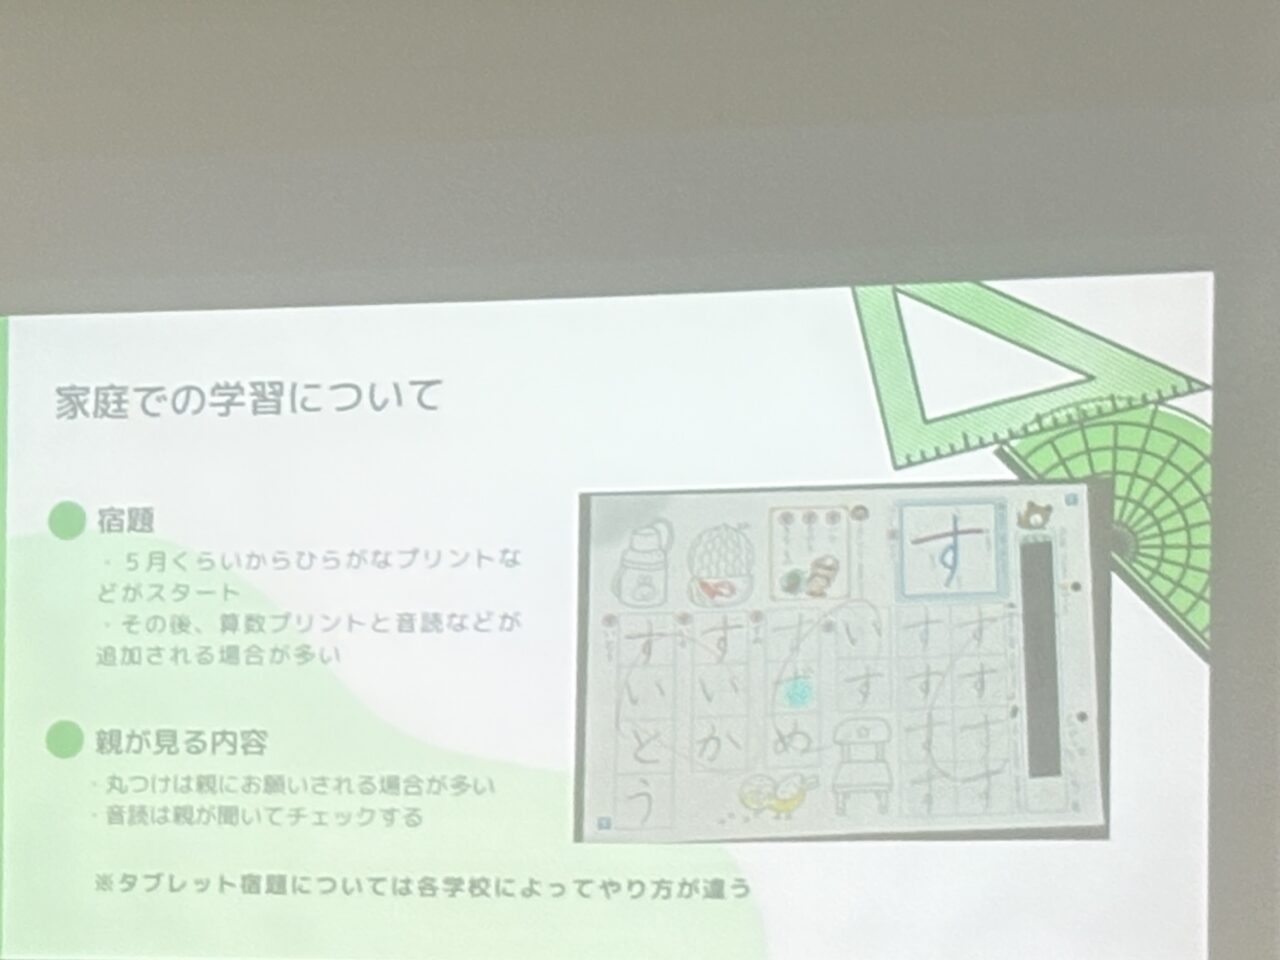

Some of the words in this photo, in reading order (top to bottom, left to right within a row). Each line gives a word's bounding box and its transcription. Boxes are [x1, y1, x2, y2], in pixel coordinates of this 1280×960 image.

[55, 379, 444, 421] 家庭での学習について
[97, 505, 156, 535] 宿題
[912, 513, 986, 587] す
[97, 582, 241, 604] どがスタート
[95, 644, 341, 668] 追加される場合が多い
[95, 727, 269, 758] 親が見る内容
